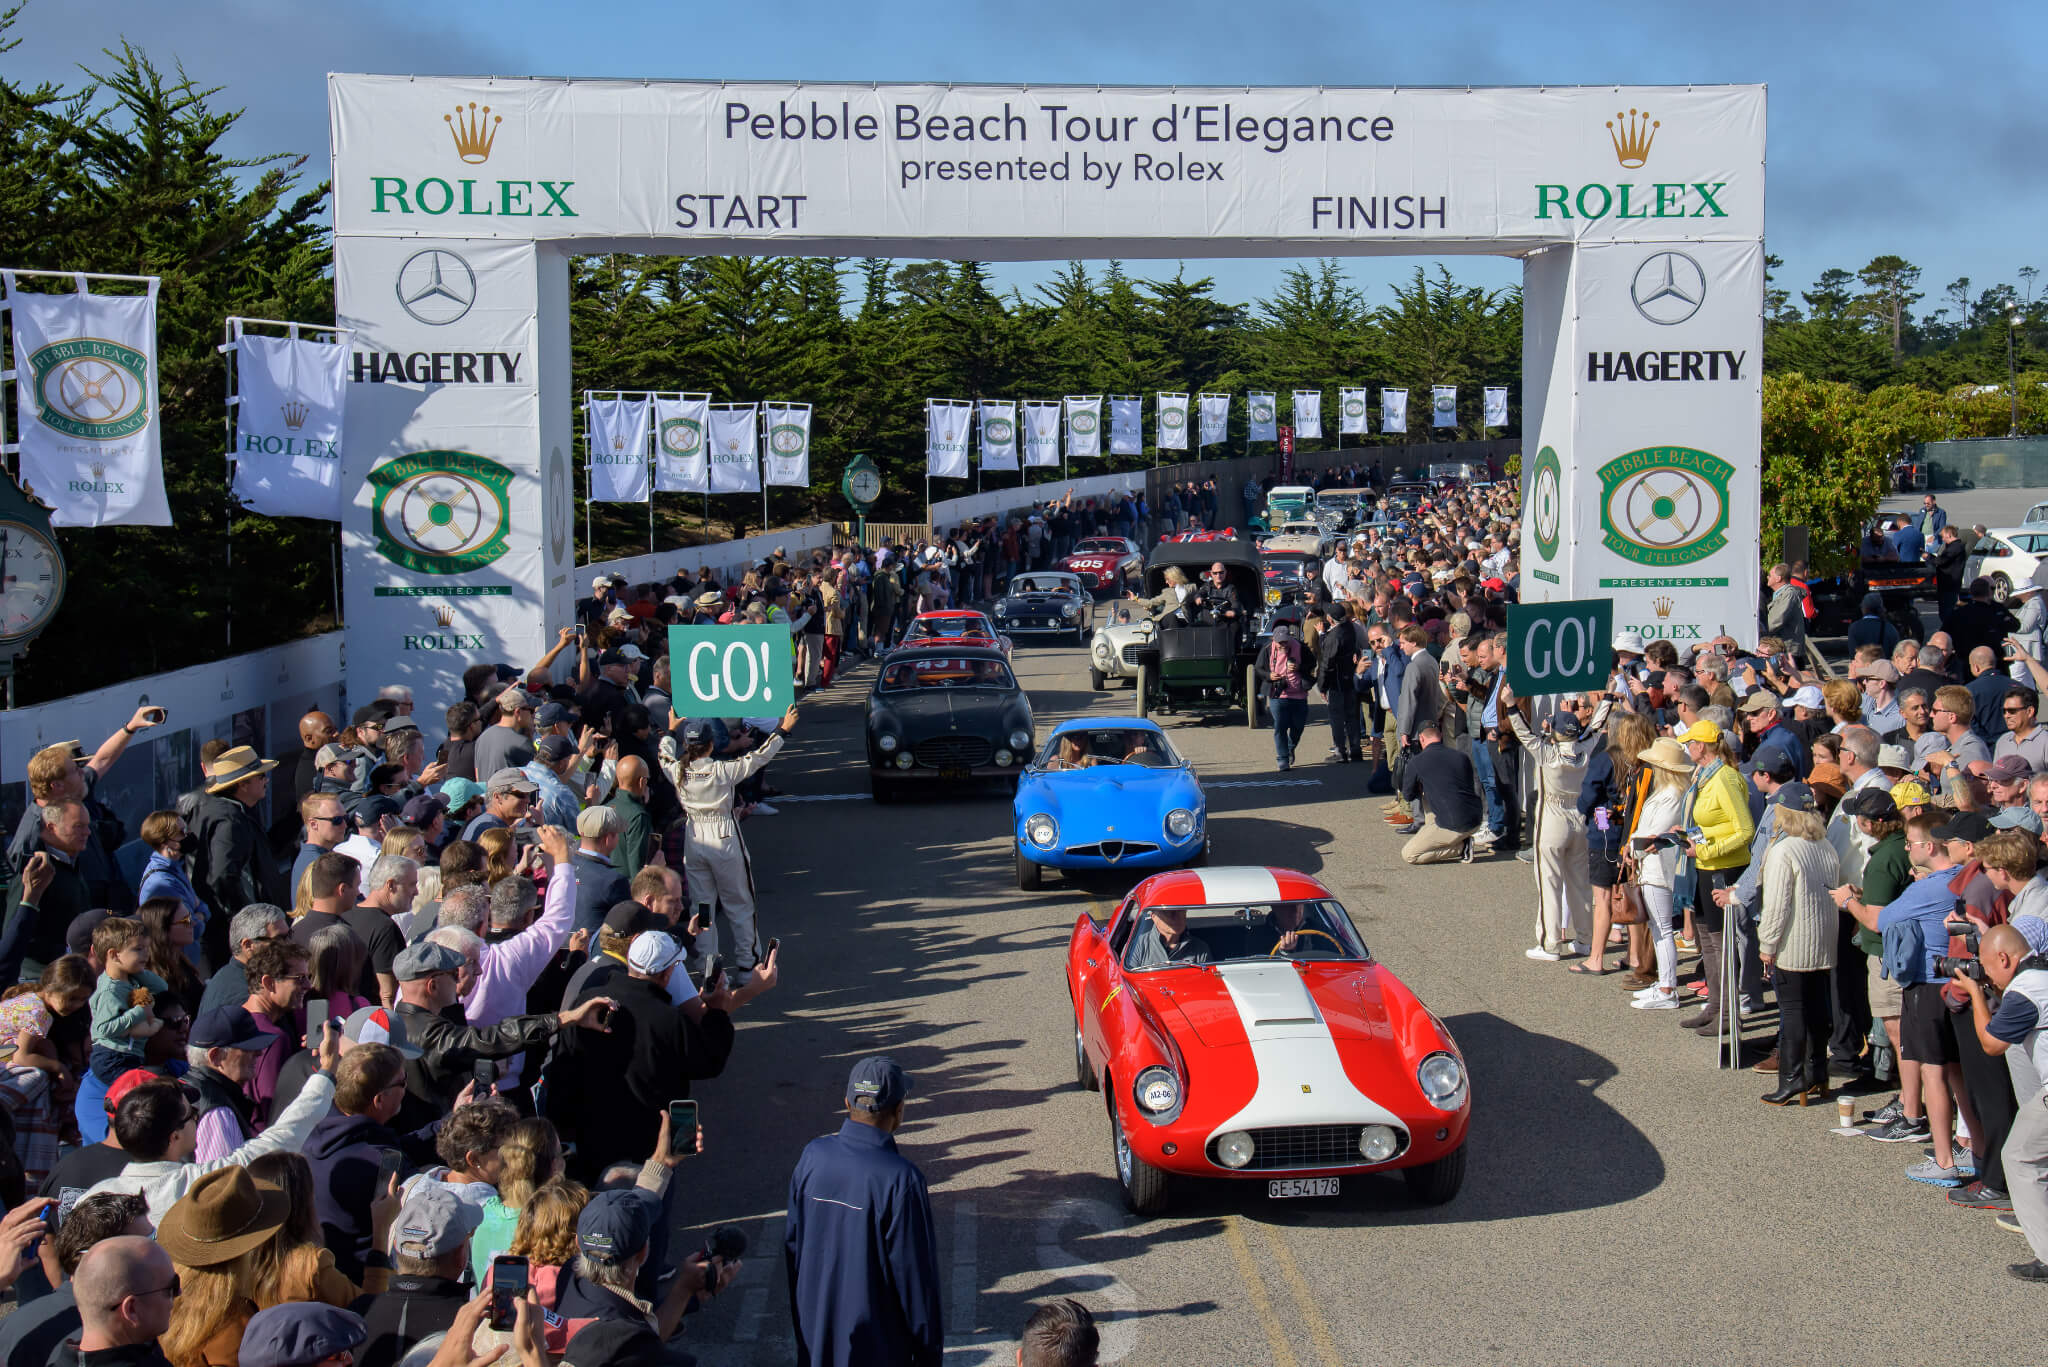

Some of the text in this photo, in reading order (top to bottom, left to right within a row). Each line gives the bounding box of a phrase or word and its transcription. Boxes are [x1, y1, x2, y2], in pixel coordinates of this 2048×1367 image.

[726, 101, 1394, 152] Pebble Beach Tour d'Elegance
[901, 152, 1225, 189] presented by Rolex
[370, 177, 579, 217] ROLEX
[1534, 183, 1729, 220] ROLEX
[676, 195, 807, 229] START
[1312, 196, 1446, 230] FINISH
[35, 343, 146, 371] PEBBLE BEACH
[353, 352, 522, 383] HAGERTY
[1588, 351, 1746, 382] HAGERTY
[45, 412, 75, 433] TOUR
[245, 434, 338, 459] ROLEX
[931, 442, 966, 452] ROLEX
[1026, 437, 1058, 445] ROLEX
[373, 454, 508, 488] PEBBLE BEACH
[594, 453, 644, 465] ROLEX
[713, 453, 753, 464] ROLEX
[1602, 449, 1730, 484] PEBBLE BEACH
[68, 480, 125, 494] ROLEX
[1606, 534, 1641, 561] TOUR
[1069, 560, 1105, 568] 405
[387, 586, 500, 595] PRESENTED BY
[1611, 577, 1718, 588] PRESENTED BY
[403, 634, 485, 651] ROLEX
[1524, 616, 1596, 679] GO!
[688, 641, 772, 702] GO!
